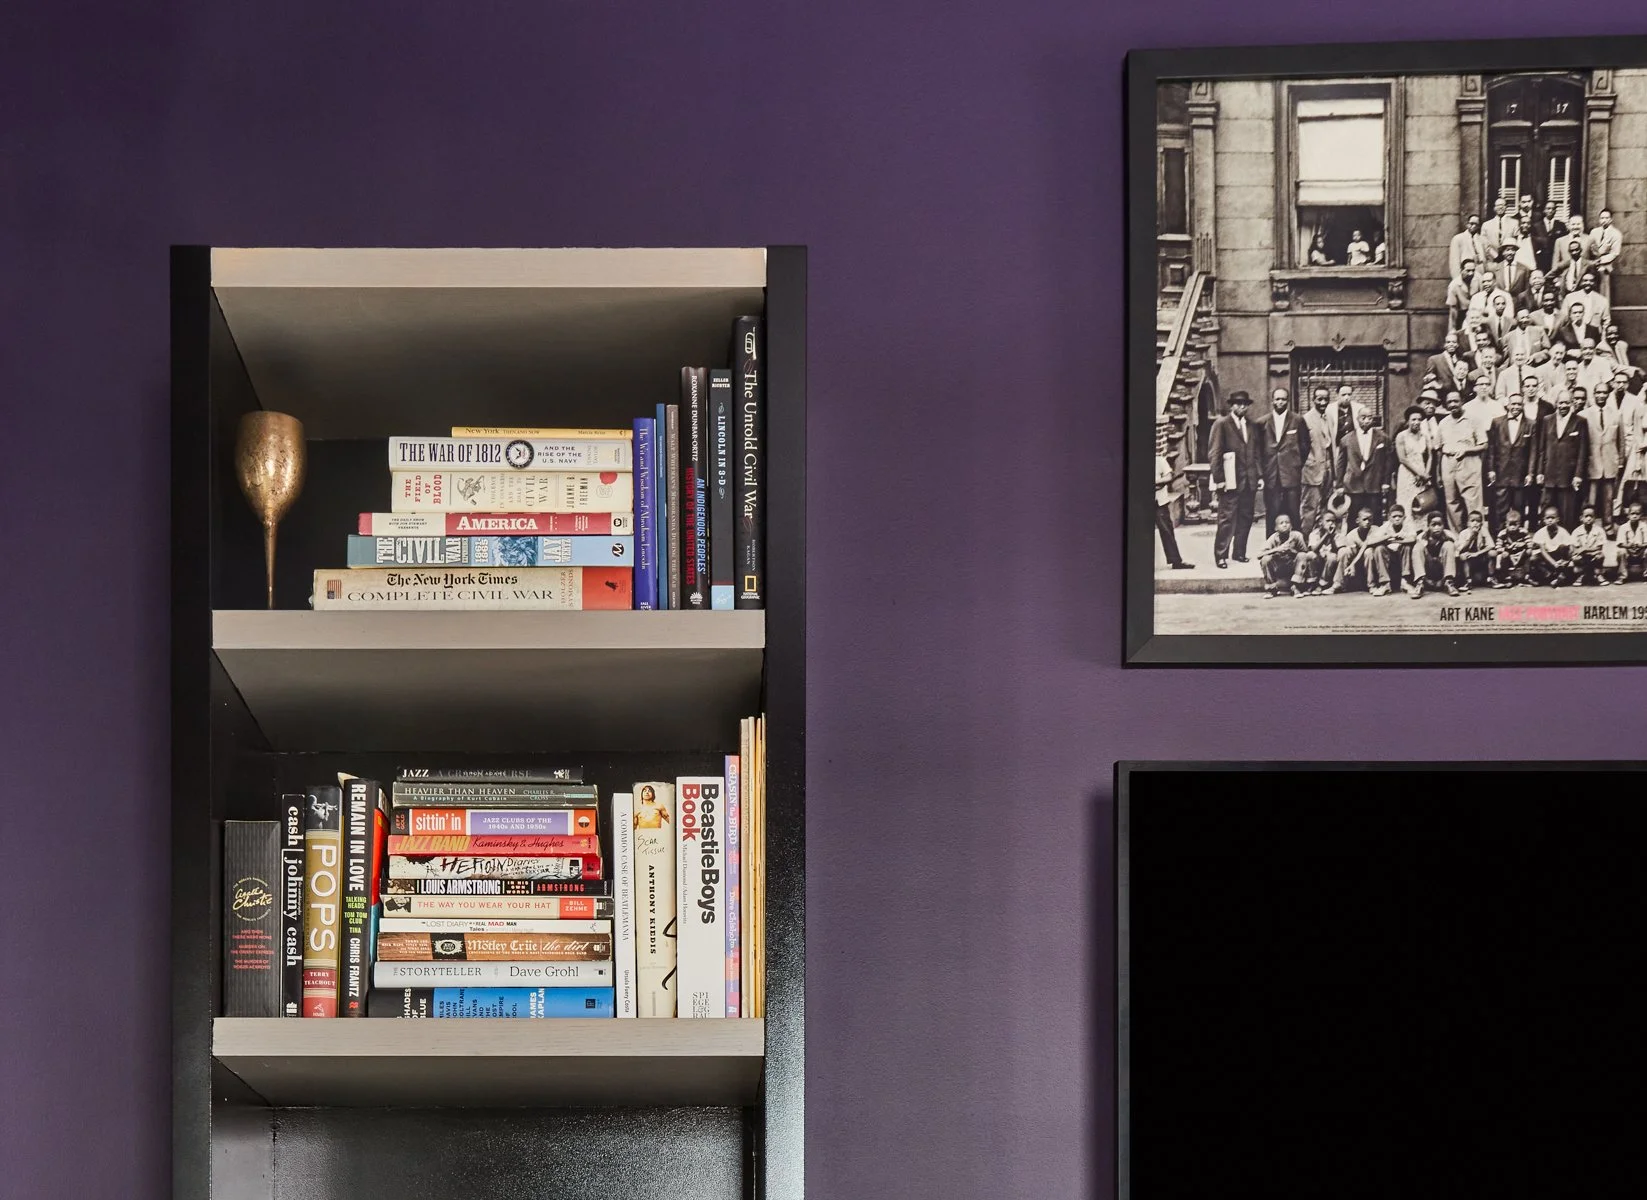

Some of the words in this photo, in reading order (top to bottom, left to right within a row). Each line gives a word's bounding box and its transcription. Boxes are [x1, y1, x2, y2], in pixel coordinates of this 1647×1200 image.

[744, 370, 758, 398] The
[744, 402, 758, 450] Untold
[400, 443, 425, 462] THE
[429, 443, 454, 462] WAR
[458, 444, 473, 463] OF
[476, 444, 501, 463] 1812
[744, 453, 758, 486] Civil
[433, 474, 442, 504] BLOOD
[744, 489, 757, 519] War
[456, 516, 538, 530] AMERICA
[396, 537, 444, 564] CIVIL
[386, 572, 410, 588] The
[412, 573, 441, 586] New
[444, 573, 476, 588] York
[478, 572, 518, 585] Times
[347, 591, 454, 602] COMPLETE
[458, 590, 509, 600] CIVIL
[513, 590, 554, 600] WAR
[1440, 607, 1460, 621] ART
[1465, 607, 1494, 621] KANE
[1584, 606, 1628, 620] HARLEM
[402, 769, 429, 778] JAZZ
[405, 787, 444, 795] HEAVIER
[351, 784, 366, 836] REMAIN
[416, 813, 448, 831] sittin'
[451, 813, 461, 831] in
[682, 784, 700, 842] Book
[287, 806, 303, 847] cash
[350, 838, 365, 854] IN
[349, 858, 364, 891] LOVE
[420, 880, 445, 894] LOUIS
[447, 879, 500, 894] ARMSTRONG
[232, 893, 272, 910] Christie
[283, 857, 303, 920] johnny
[310, 844, 337, 952] POPS
[648, 864, 656, 915] ANTHONY
[286, 926, 302, 966] cash
[349, 938, 360, 964] CHRIS
[349, 966, 360, 998] FRANTZ
[399, 968, 482, 976] STORYTELLER
[510, 966, 542, 977] Dave
[545, 966, 579, 977] Grohl
